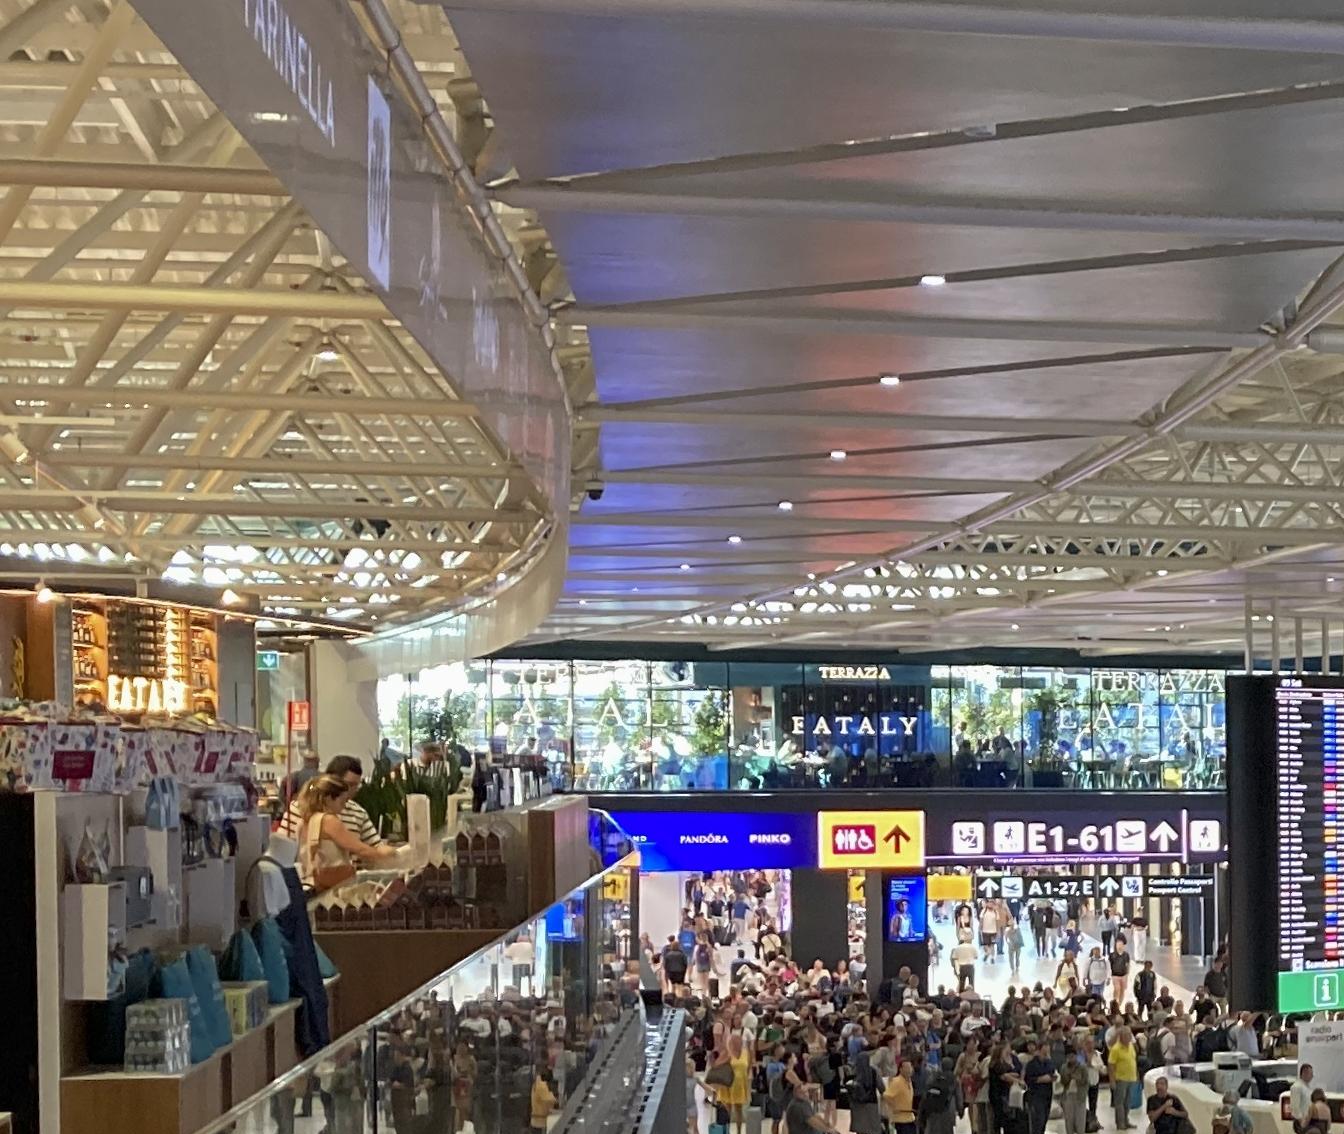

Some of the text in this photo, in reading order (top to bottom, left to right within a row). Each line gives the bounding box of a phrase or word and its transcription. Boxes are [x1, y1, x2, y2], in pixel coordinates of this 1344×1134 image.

[819, 665, 891, 680] TERRAZZA
[791, 716, 918, 735] EATALY
[749, 834, 791, 844] PINKO
[1027, 823, 1113, 853] E1-61
